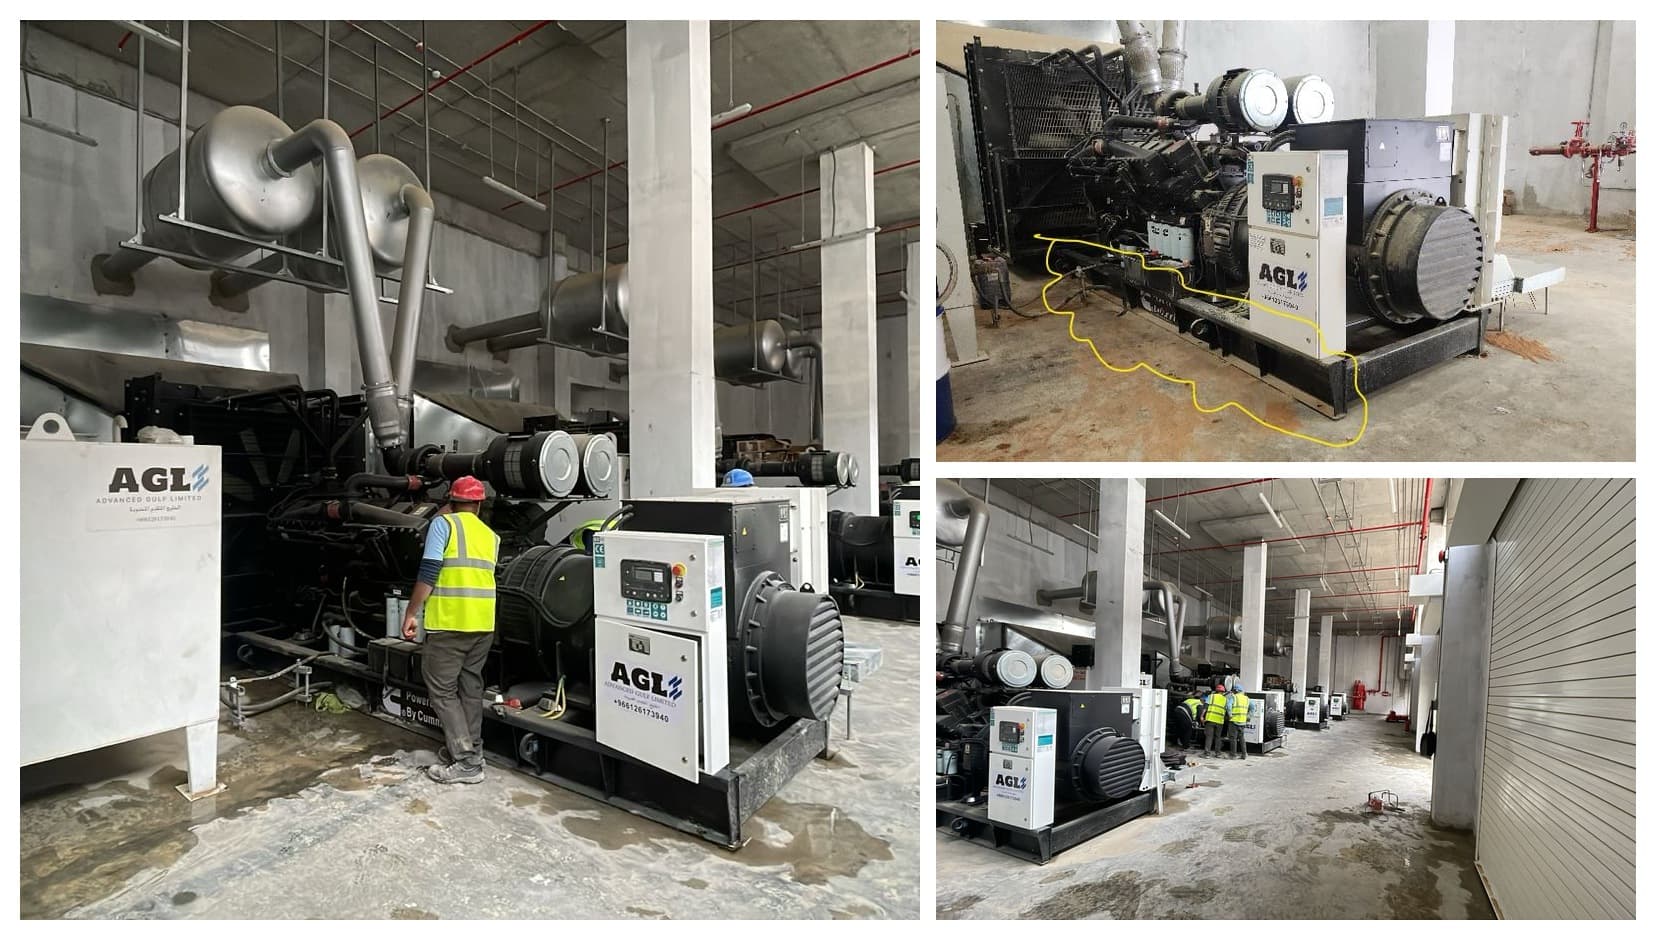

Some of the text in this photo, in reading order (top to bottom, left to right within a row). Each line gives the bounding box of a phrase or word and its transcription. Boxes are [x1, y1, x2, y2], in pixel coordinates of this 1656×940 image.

[1259, 263, 1297, 290] AGL
[109, 467, 191, 493] AGL
[96, 496, 142, 504] ADVANCED
[146, 495, 166, 503] GULF
[611, 661, 668, 698] AGL
[406, 691, 433, 707] Power
[406, 706, 441, 727] By Cumm
[996, 774, 1020, 788] AGL
